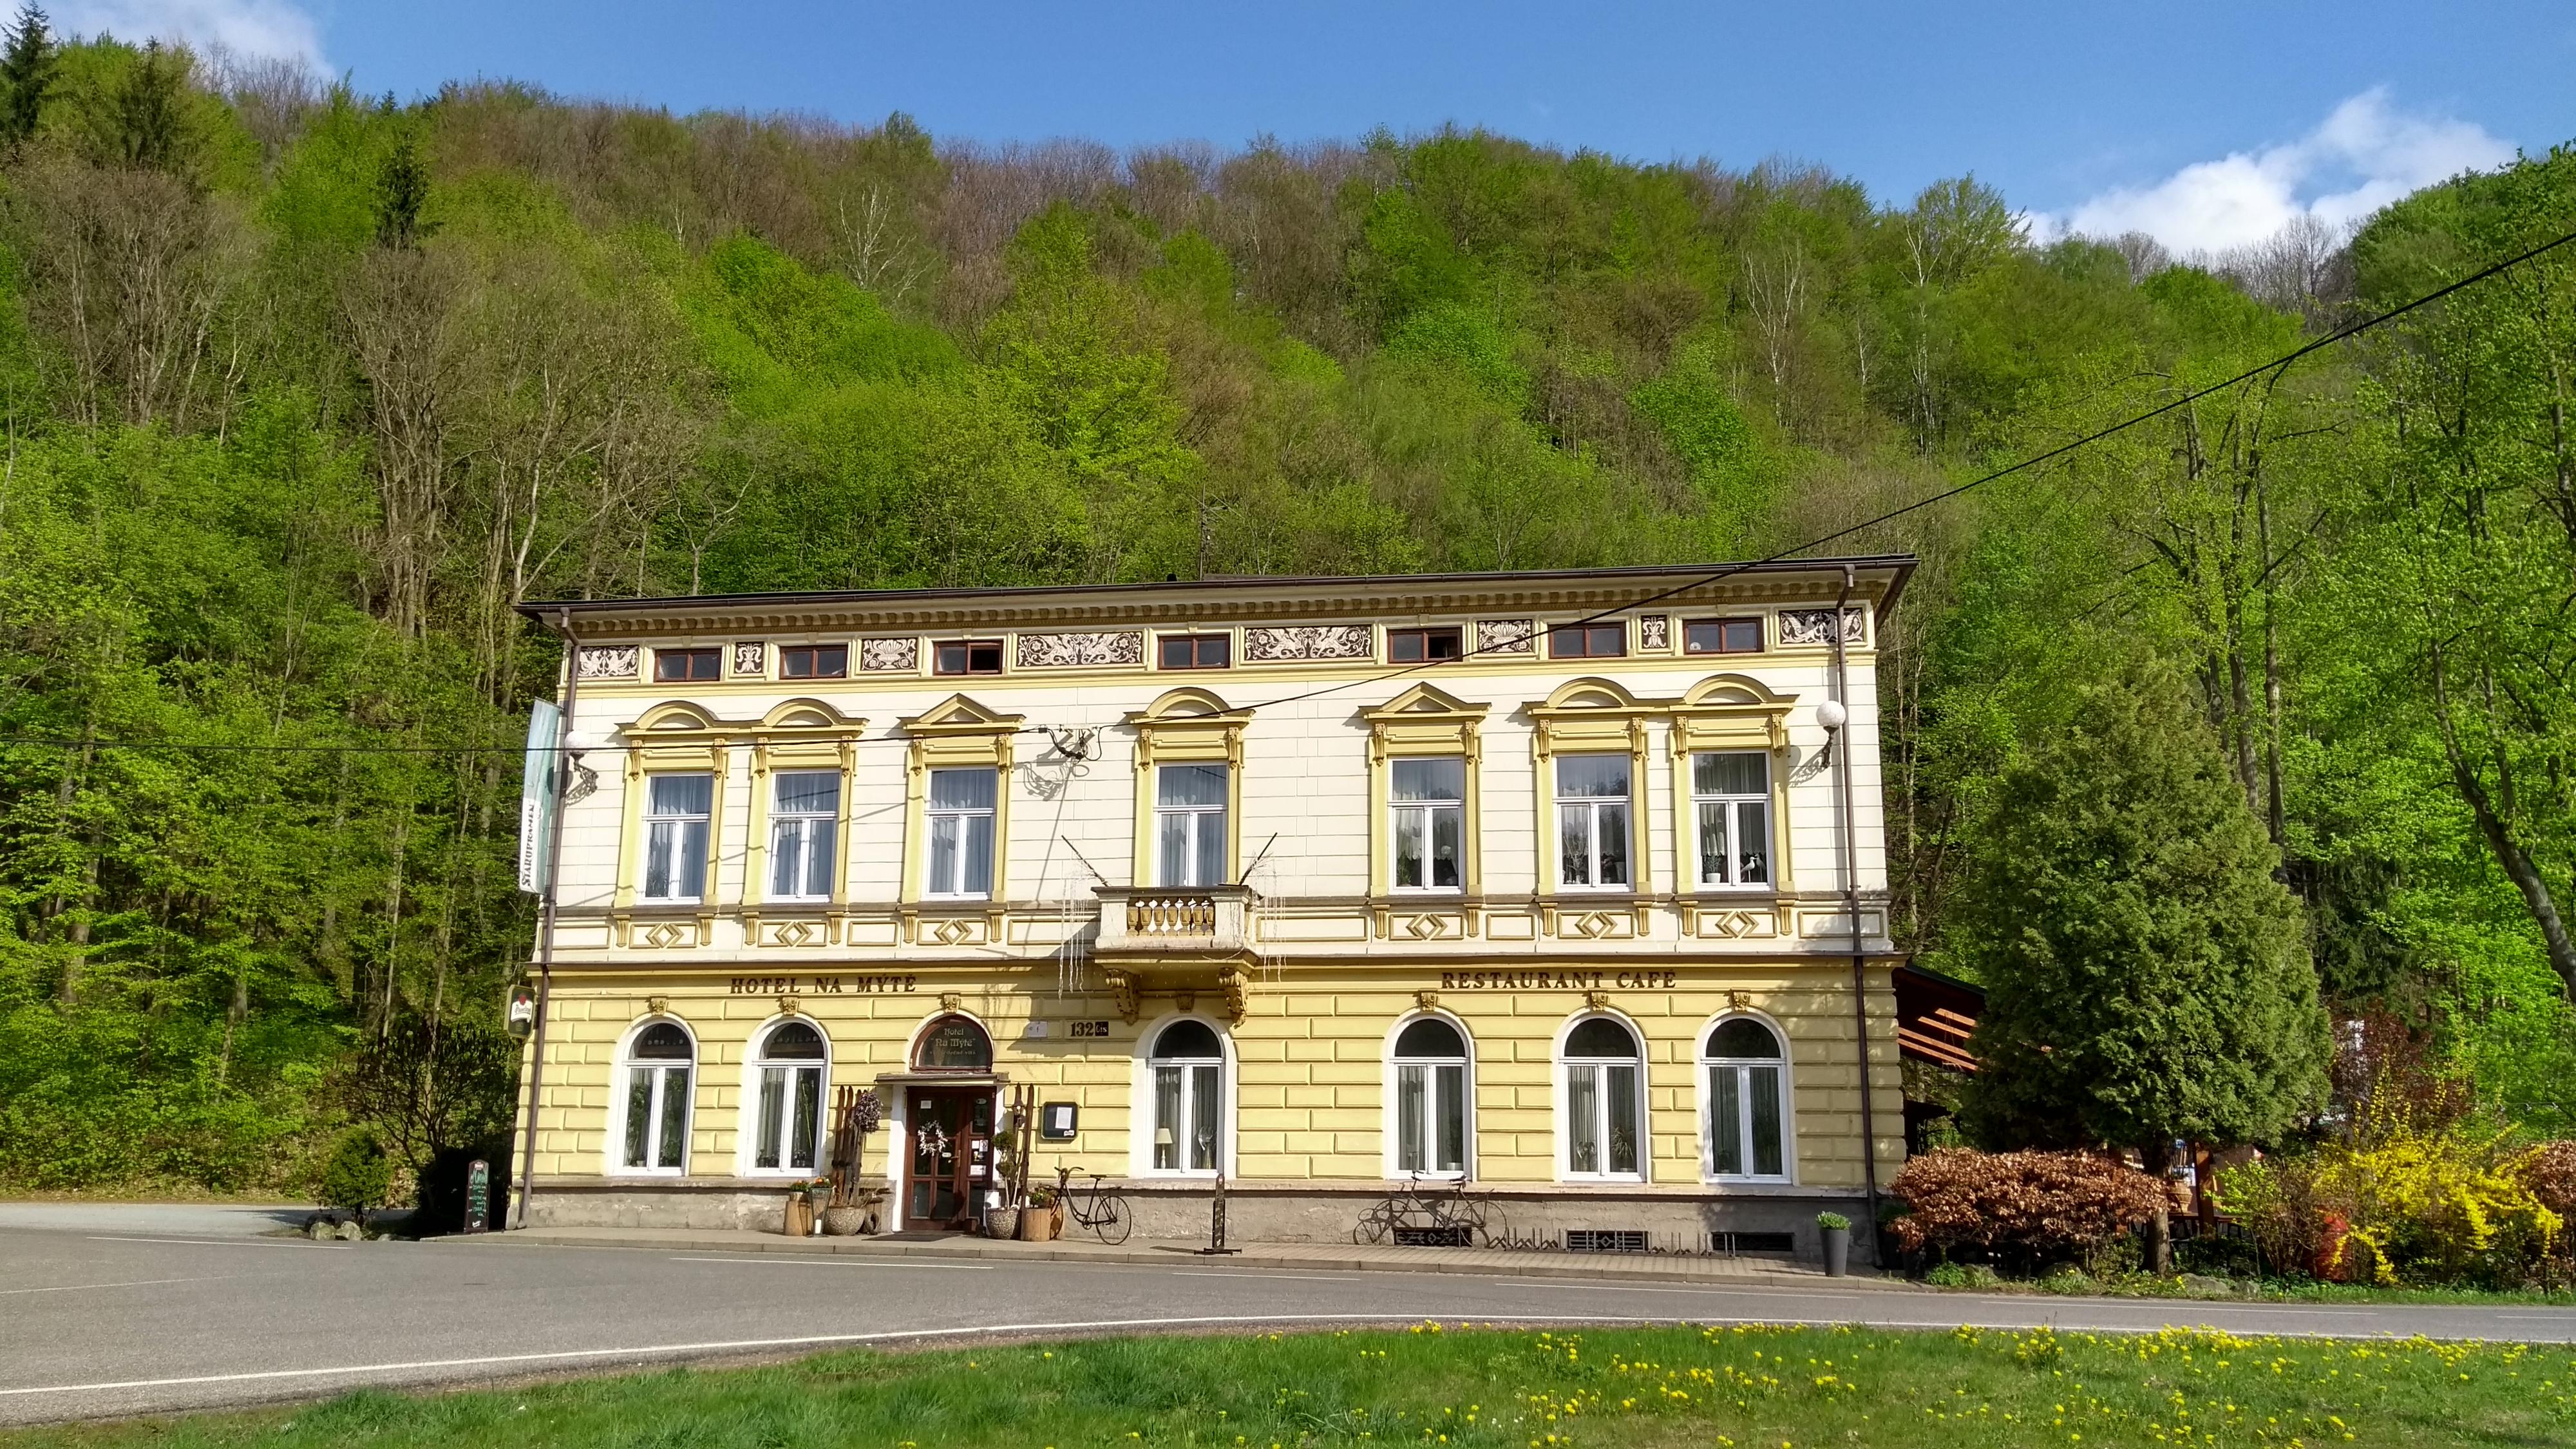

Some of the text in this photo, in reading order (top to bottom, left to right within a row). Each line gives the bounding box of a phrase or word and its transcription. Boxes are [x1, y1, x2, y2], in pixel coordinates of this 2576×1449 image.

[522, 804, 535, 887] STAROPRAMEN
[730, 973, 916, 994] HOTEL NA MÝTĚ
[1441, 969, 1676, 989] RESTAURANT CAFÉ
[944, 1028, 964, 1036] Hotel
[1070, 1021, 1094, 1037] 132
